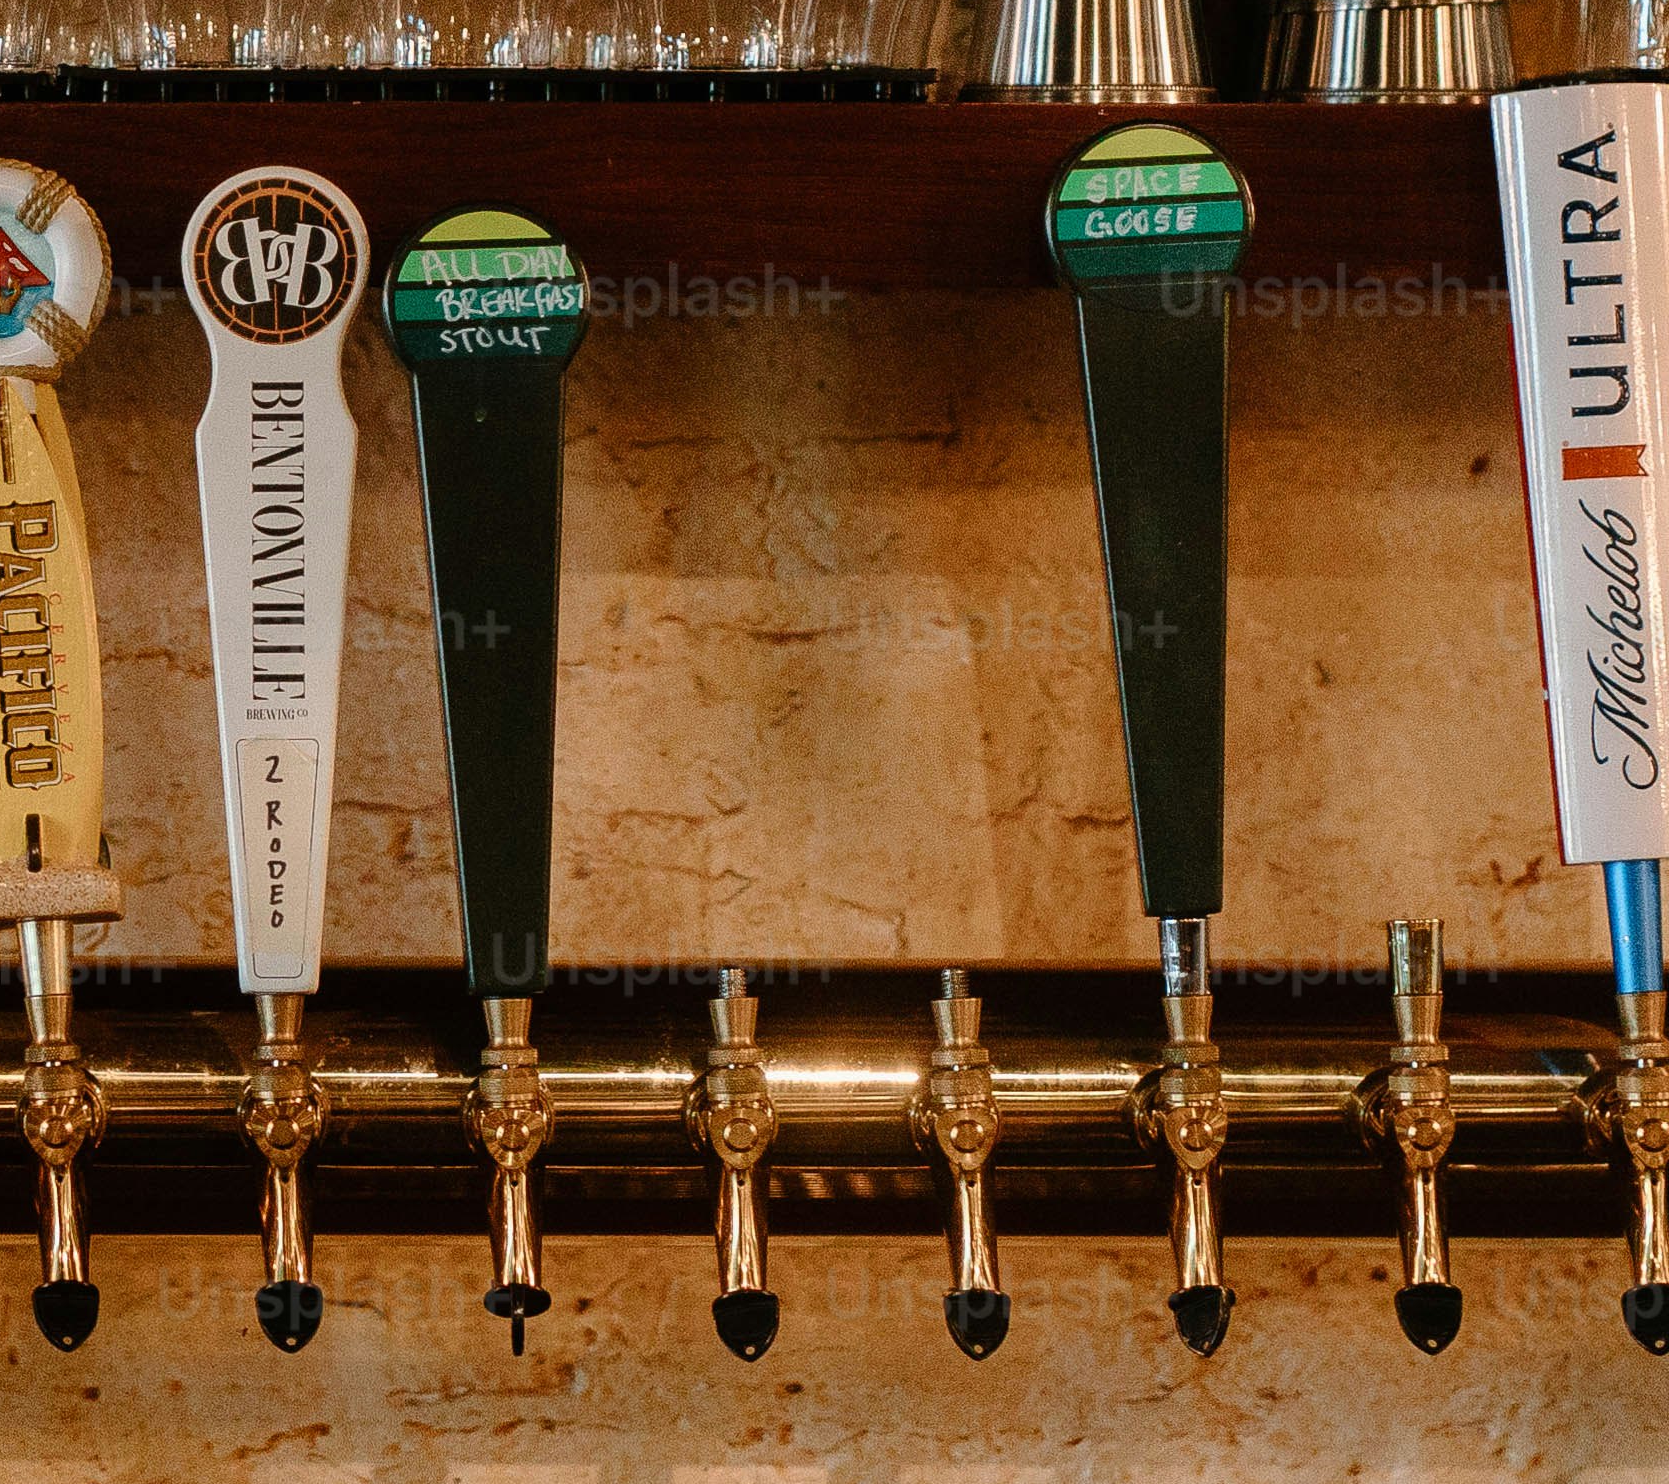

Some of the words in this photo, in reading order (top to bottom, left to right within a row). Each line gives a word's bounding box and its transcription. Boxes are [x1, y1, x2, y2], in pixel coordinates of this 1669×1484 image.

[1086, 163, 1202, 204] SPACE
[1084, 206, 1198, 239] GOOSE
[495, 244, 567, 281] DAY
[1557, 130, 1631, 418] ULTRA
[435, 282, 585, 322] BREAKFAST
[439, 326, 551, 354] STOUT
[251, 382, 306, 701] BENTONVILLE
[1578, 498, 1660, 791] Michelob
[48, 591, 76, 785] CERVEZA
[246, 708, 295, 721] BREWING
[265, 755, 283, 783] 2
[266, 800, 287, 928] RODEO
